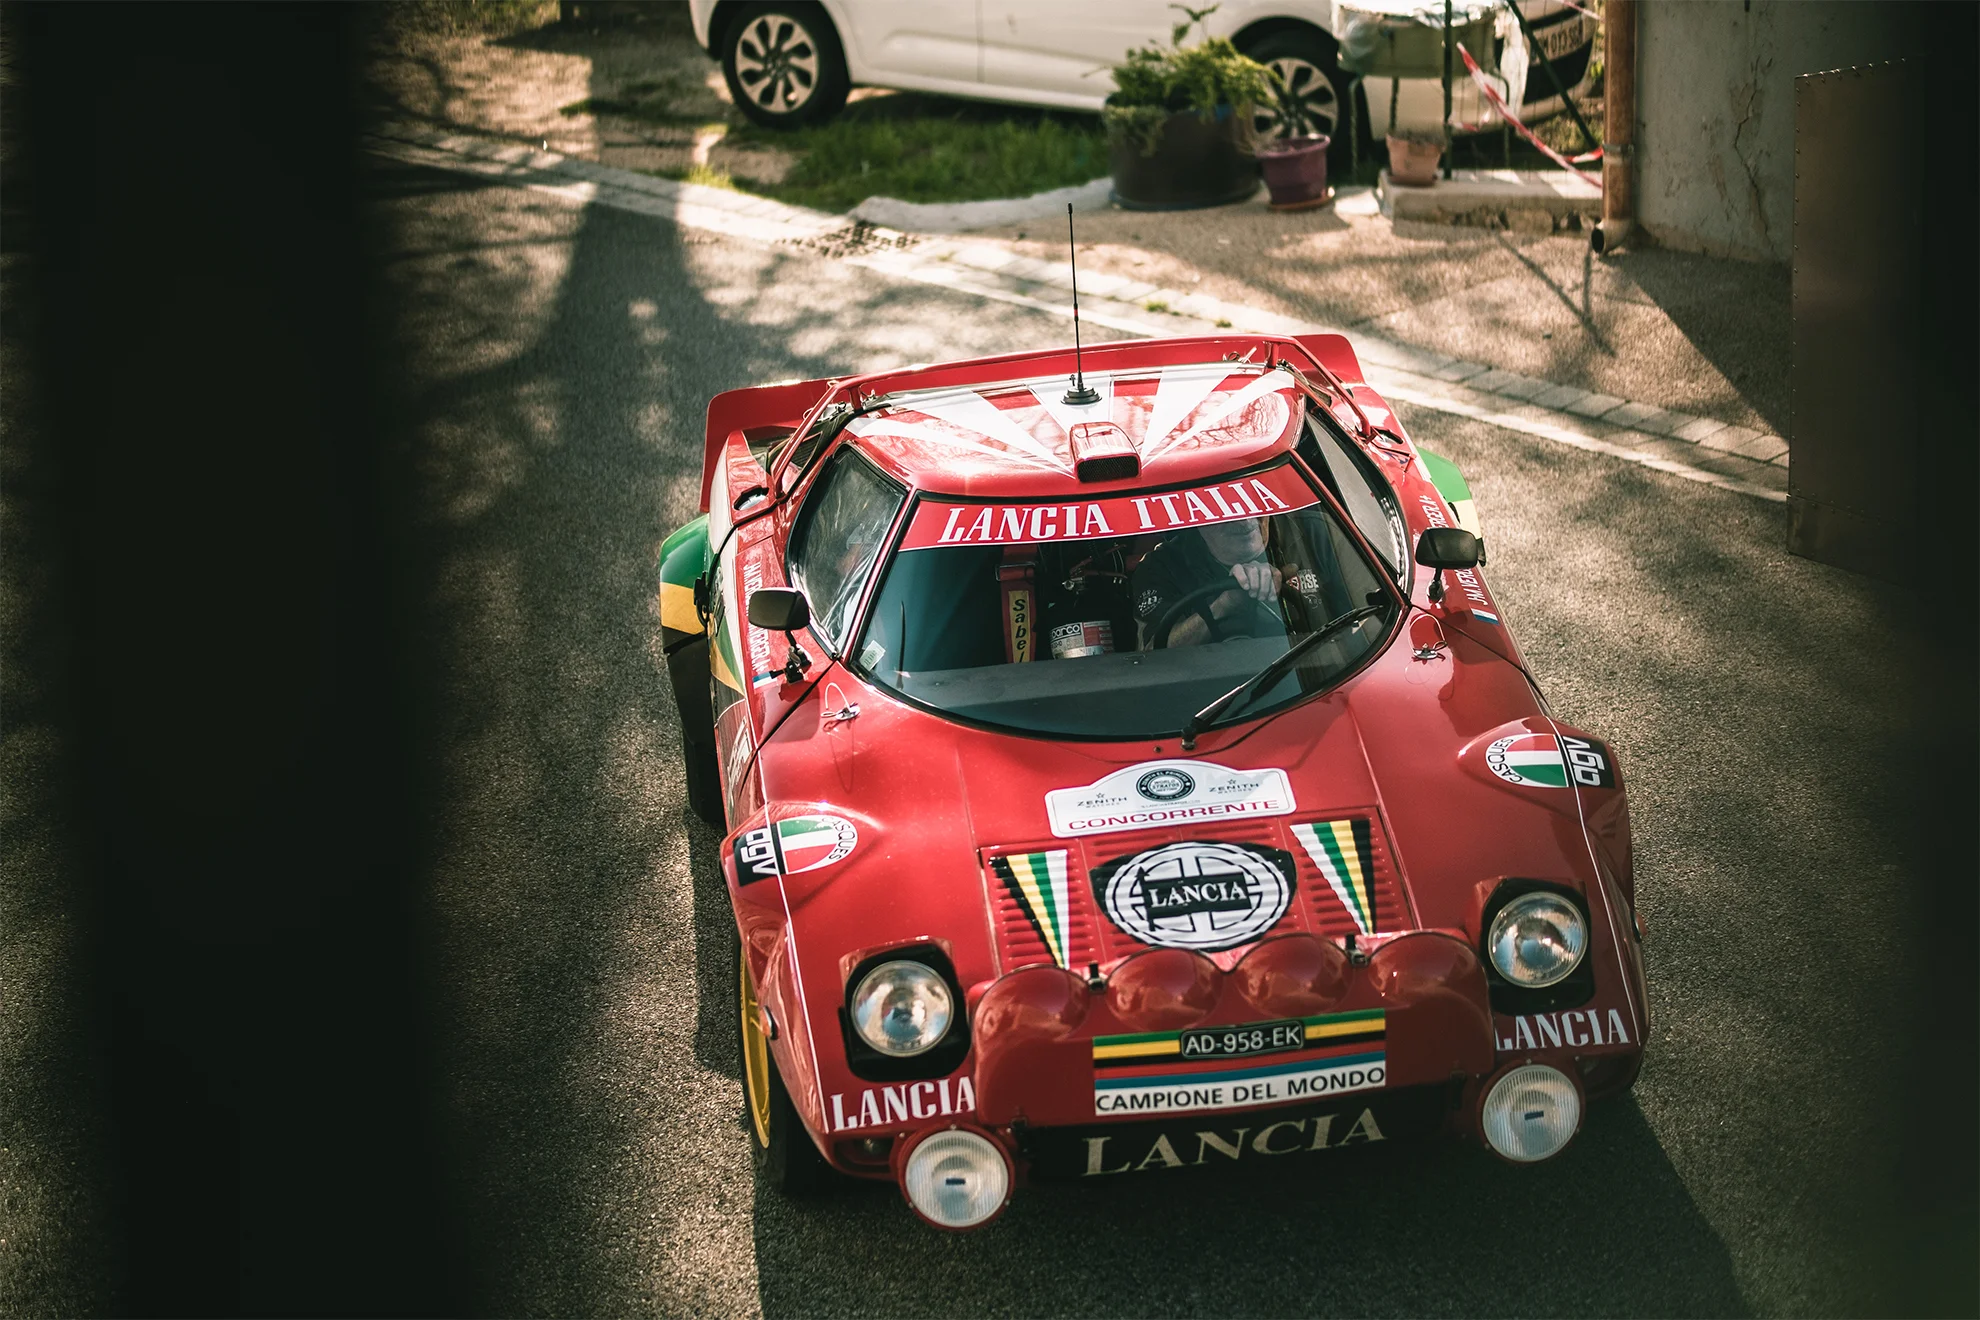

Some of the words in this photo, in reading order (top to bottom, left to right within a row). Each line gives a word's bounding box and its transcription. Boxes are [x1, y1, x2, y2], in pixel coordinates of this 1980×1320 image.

[937, 502, 1114, 543] LANCIA
[1130, 478, 1290, 530] ITALIA
[1487, 738, 1523, 783] CASQUES
[1077, 796, 1127, 806] ZENITH
[1207, 782, 1260, 792] ZENITH
[1069, 800, 1279, 830] CONCORRENTE
[822, 816, 856, 861] CASQUES
[1148, 881, 1248, 908] LANCIA
[1185, 1026, 1301, 1056] AD-958-EK
[1495, 1008, 1631, 1051] LANCIA
[830, 1076, 976, 1132] LANCIA
[1096, 1089, 1223, 1112] CAMPIONE
[1233, 1083, 1277, 1103] DEL
[1287, 1067, 1385, 1096] MONDO
[1081, 1108, 1388, 1177] LANCIA
